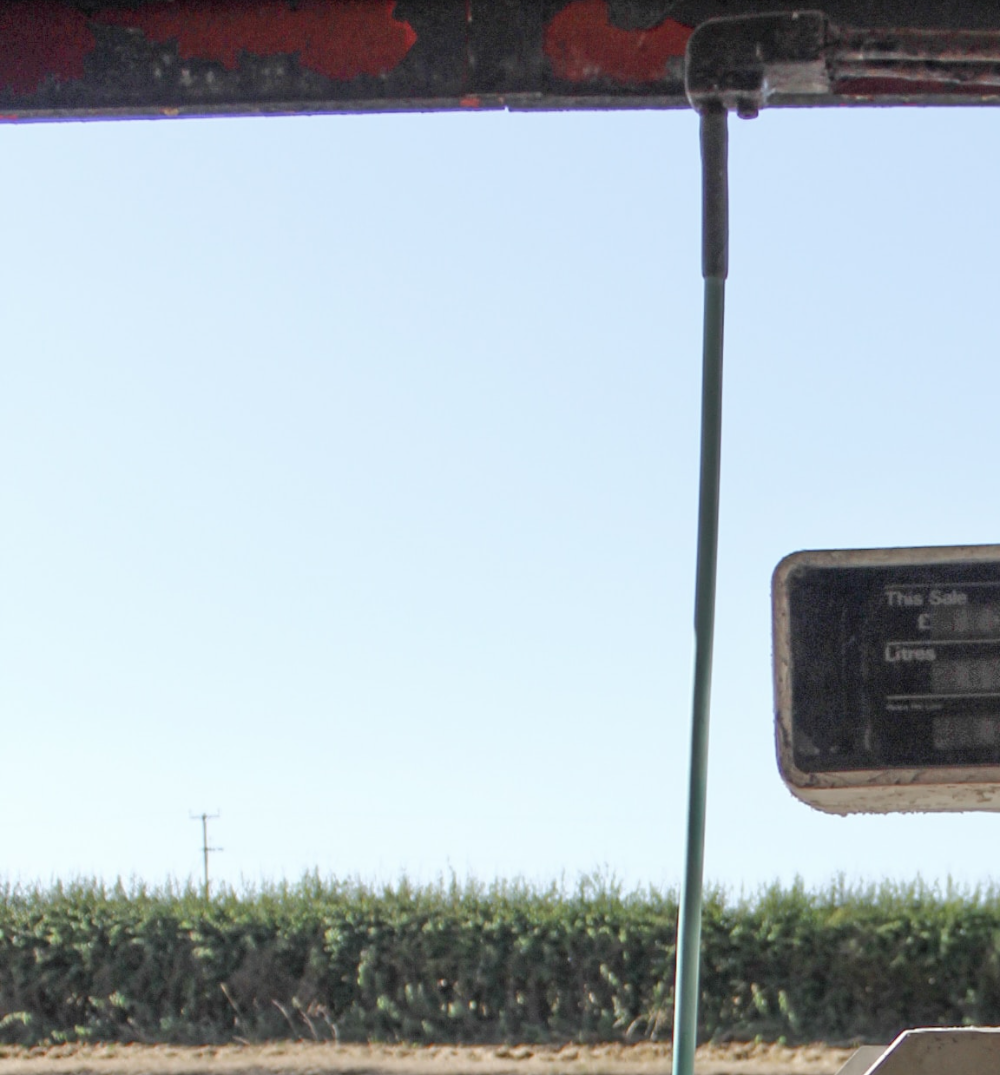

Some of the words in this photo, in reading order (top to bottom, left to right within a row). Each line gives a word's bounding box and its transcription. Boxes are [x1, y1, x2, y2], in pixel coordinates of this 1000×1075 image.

[886, 591, 923, 606] This
[929, 590, 968, 605] Sale
[885, 645, 937, 662] Litres
